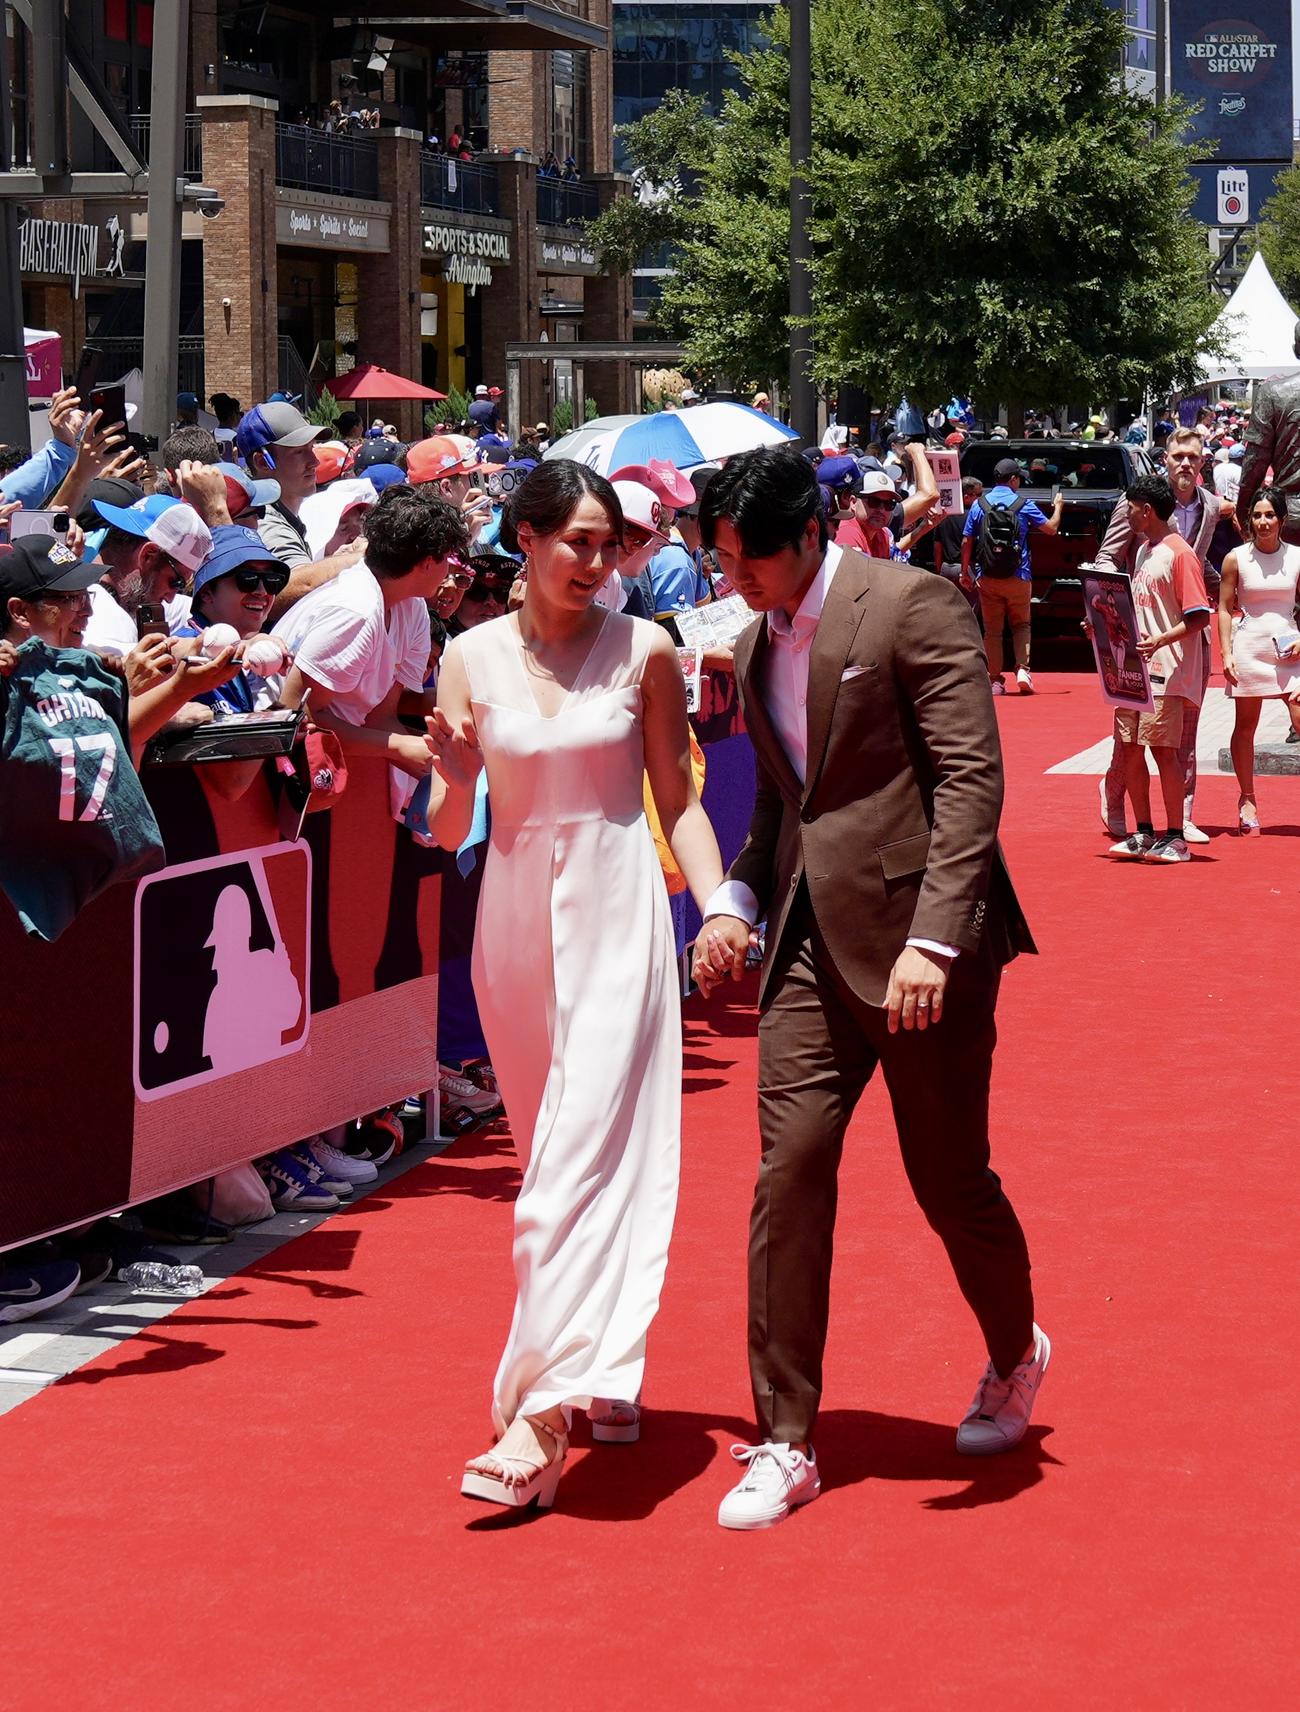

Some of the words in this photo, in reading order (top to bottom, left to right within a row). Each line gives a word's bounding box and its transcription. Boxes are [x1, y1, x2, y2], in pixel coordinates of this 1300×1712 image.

[1185, 44, 1217, 58] RED
[1218, 44, 1277, 58] CARPET
[1208, 59, 1257, 73] SHOW
[1221, 180, 1246, 195] Lite
[289, 209, 311, 235] Sports
[320, 213, 341, 239] Spirits
[348, 217, 368, 238] Social
[425, 225, 467, 254] SPORTS
[468, 232, 476, 255] &
[476, 231, 510, 260] SOCIAL
[18, 218, 99, 299] BASEBALLISM
[445, 253, 492, 296] Arlington
[1118, 669, 1143, 682] TANNER
[48, 732, 117, 822] 17
